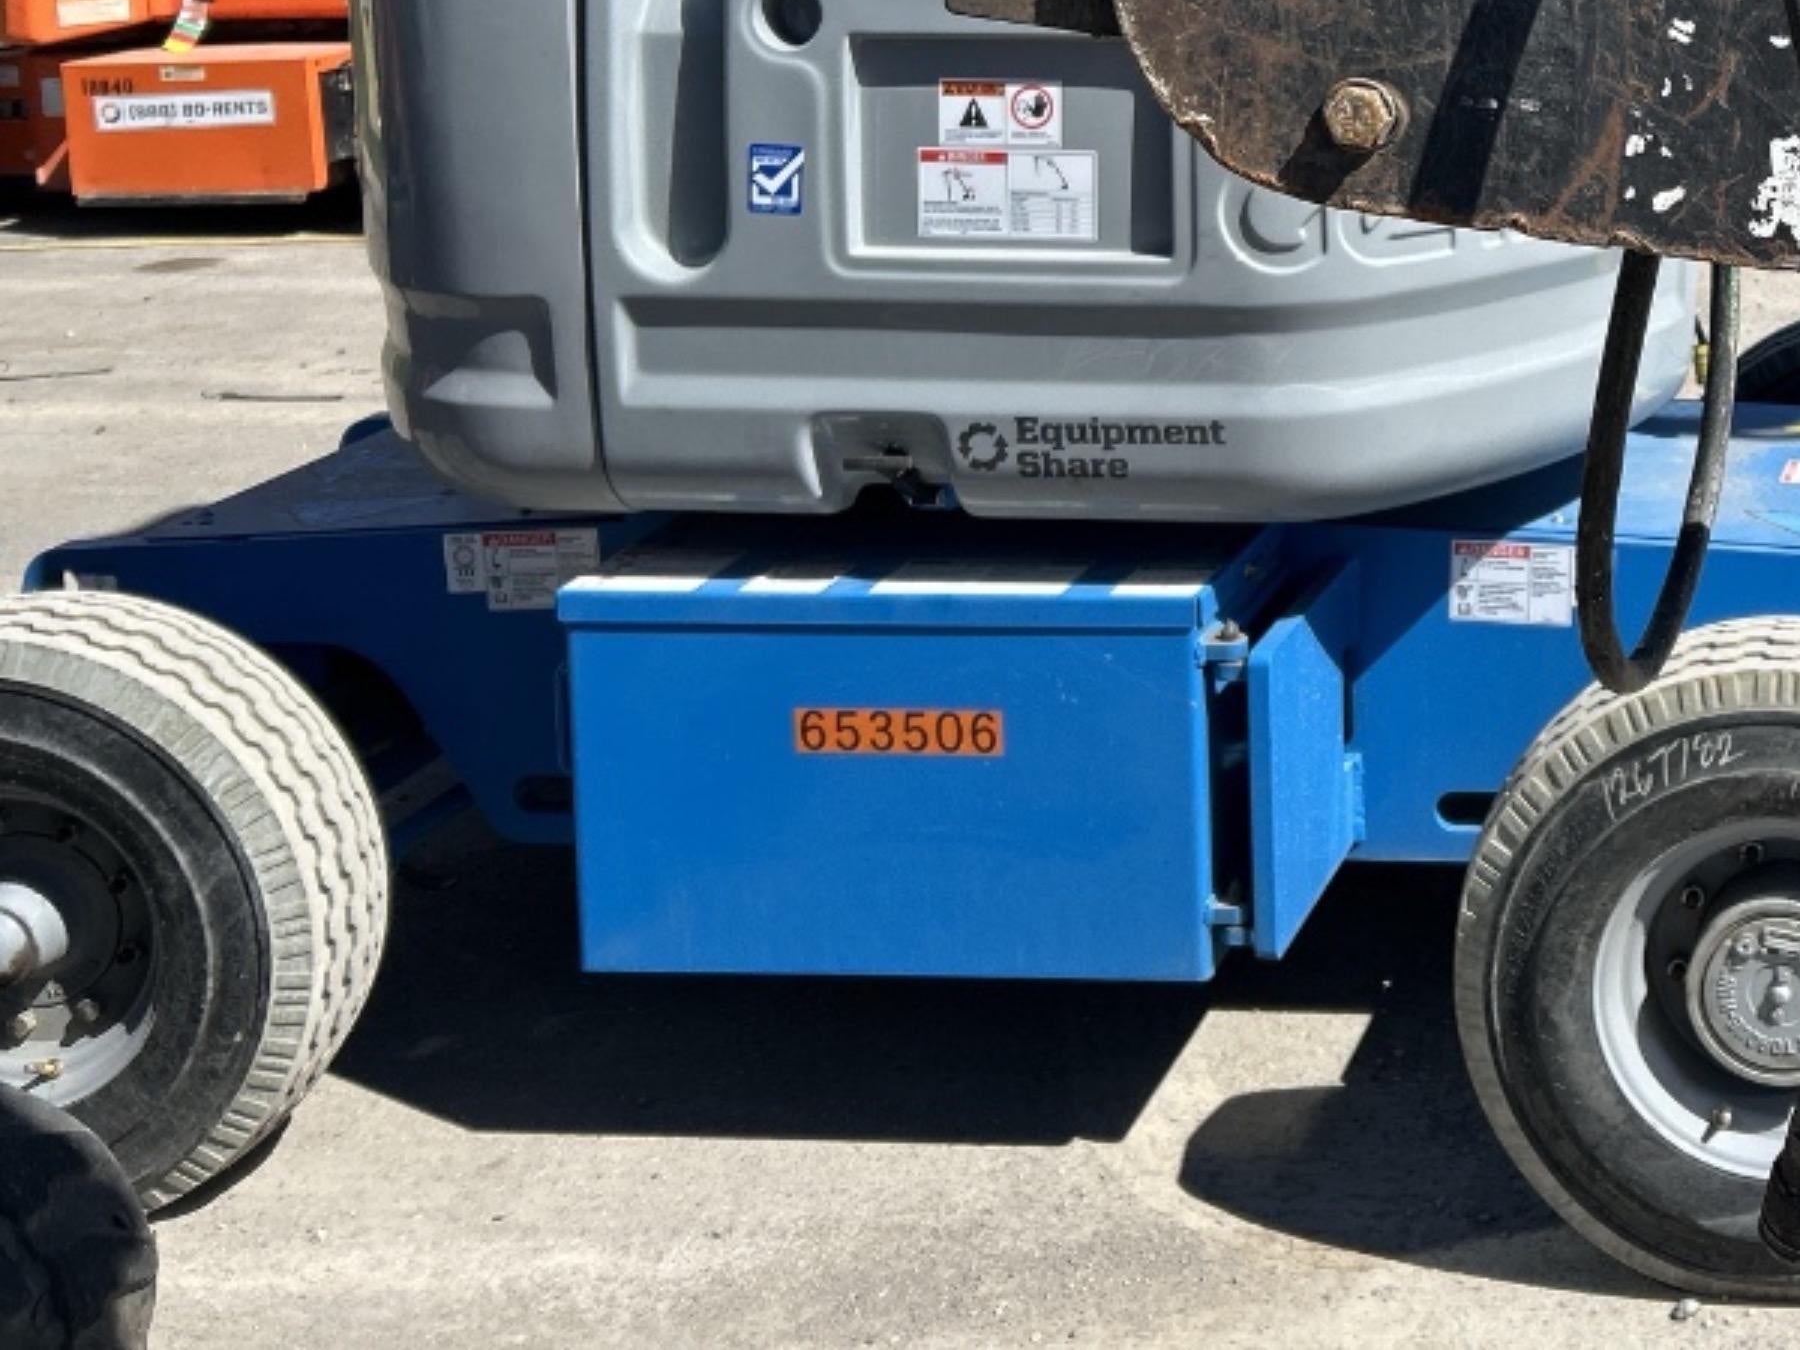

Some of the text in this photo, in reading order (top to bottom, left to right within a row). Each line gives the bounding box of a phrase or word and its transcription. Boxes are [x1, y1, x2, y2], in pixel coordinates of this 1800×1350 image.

[1014, 416, 1227, 450] Equipment
[1016, 451, 1130, 479] Share
[800, 710, 998, 754] 653506
